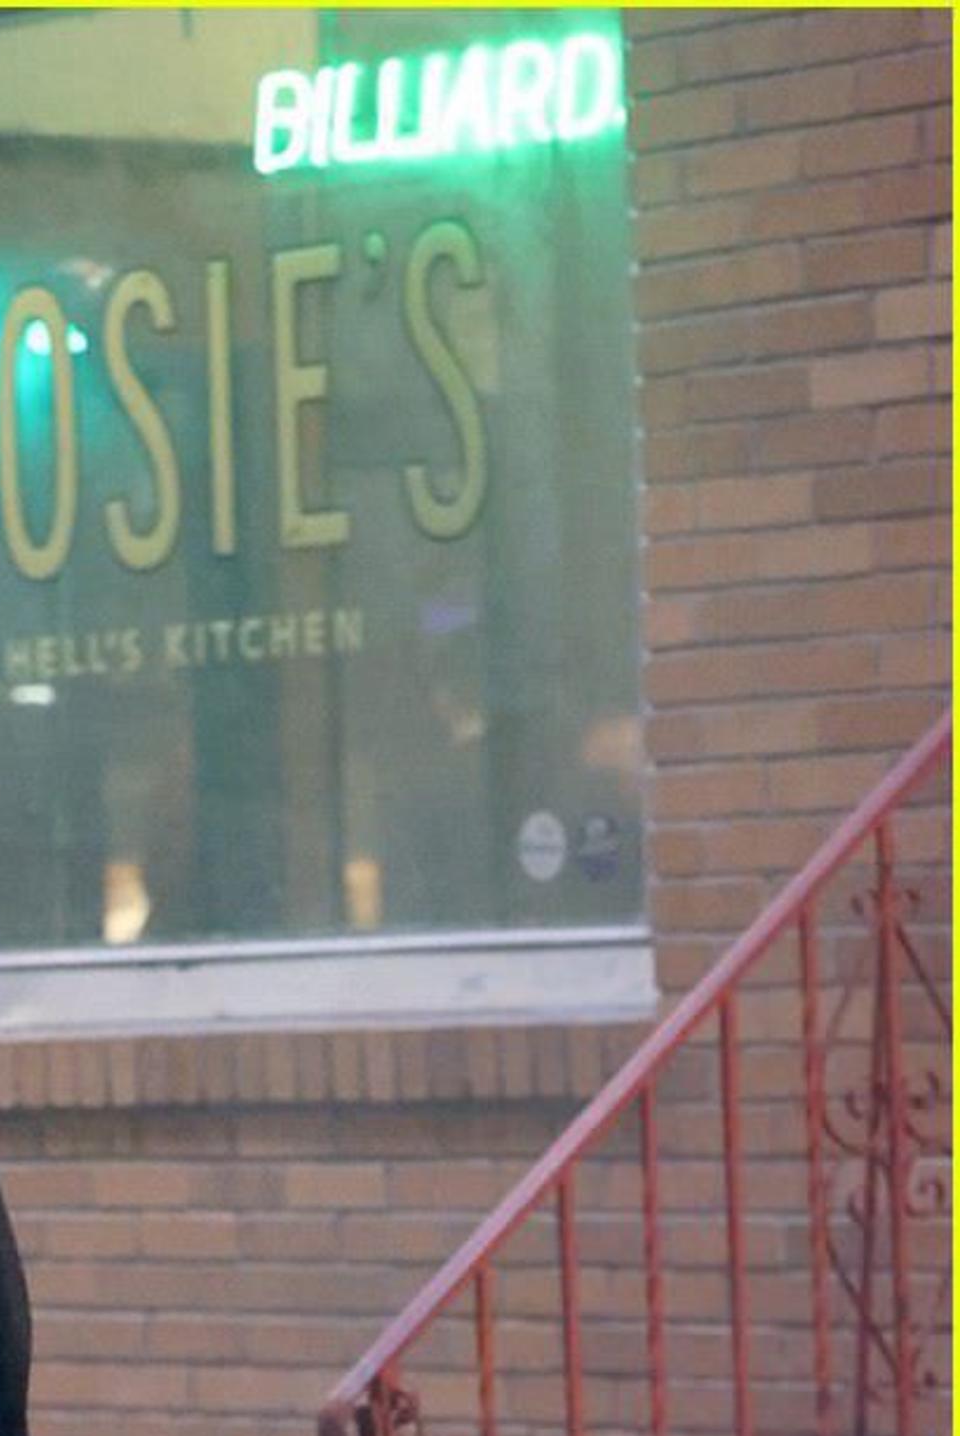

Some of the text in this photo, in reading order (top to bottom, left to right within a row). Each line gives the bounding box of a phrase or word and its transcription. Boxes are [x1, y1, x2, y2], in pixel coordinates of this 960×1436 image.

[254, 34, 626, 174] BILLIARD
[6, 608, 364, 680] HELL'S KITCHEN
